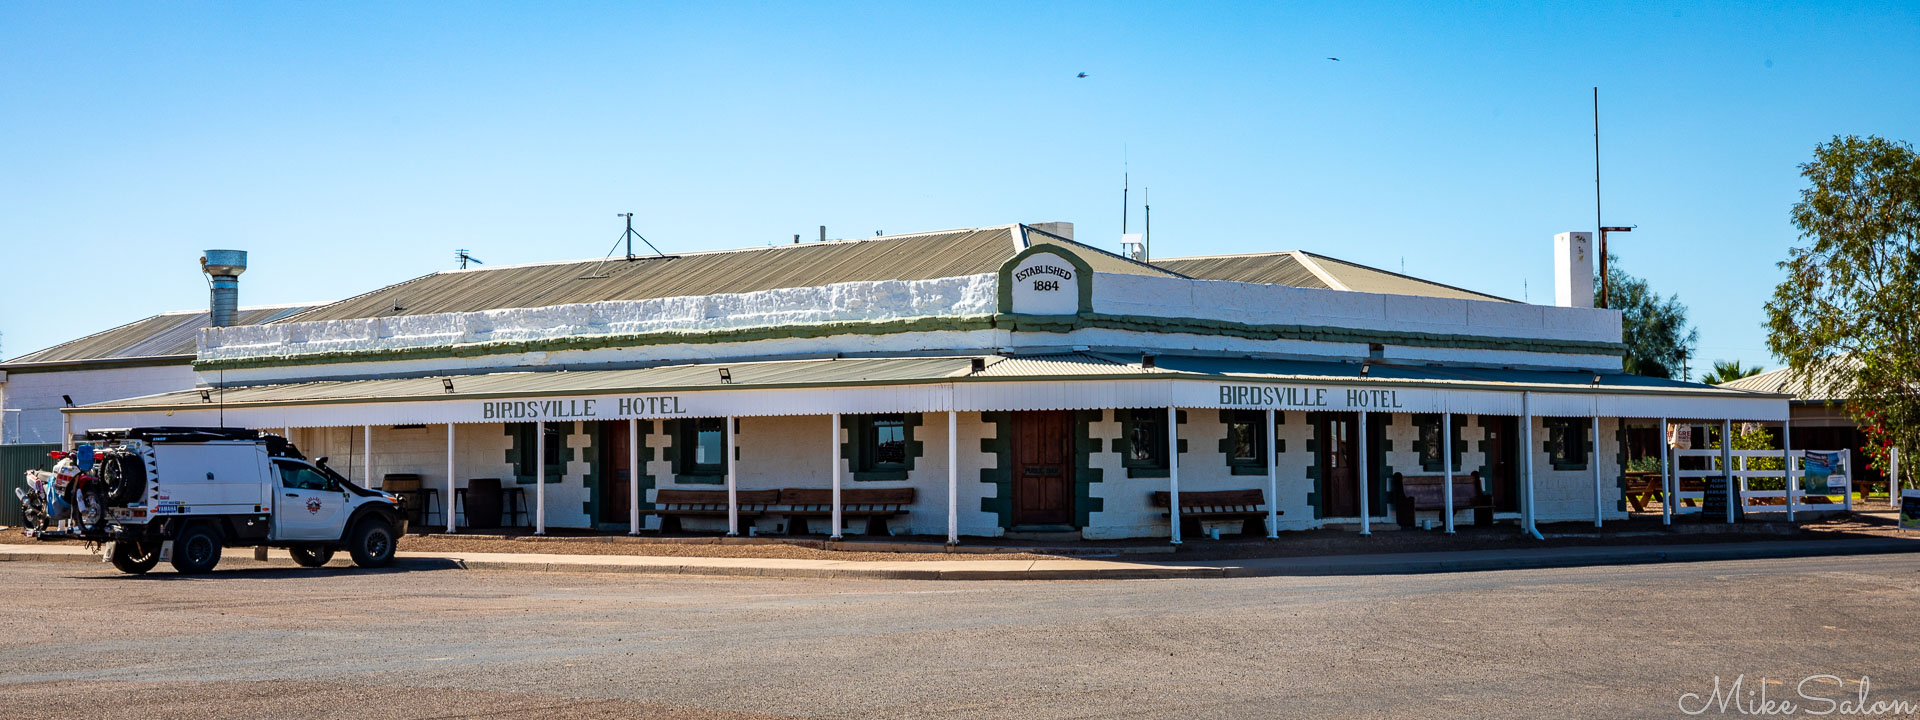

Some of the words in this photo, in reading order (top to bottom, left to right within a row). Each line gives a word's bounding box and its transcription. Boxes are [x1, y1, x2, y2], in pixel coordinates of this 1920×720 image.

[1015, 265, 1072, 282] ESTABLISHED
[1033, 280, 1059, 291] 1884
[1219, 385, 1328, 407] BIRDSVILLE
[1346, 388, 1403, 408] HOTEL
[483, 399, 596, 419] BIRDSVILLE
[619, 396, 687, 416] HOTEL
